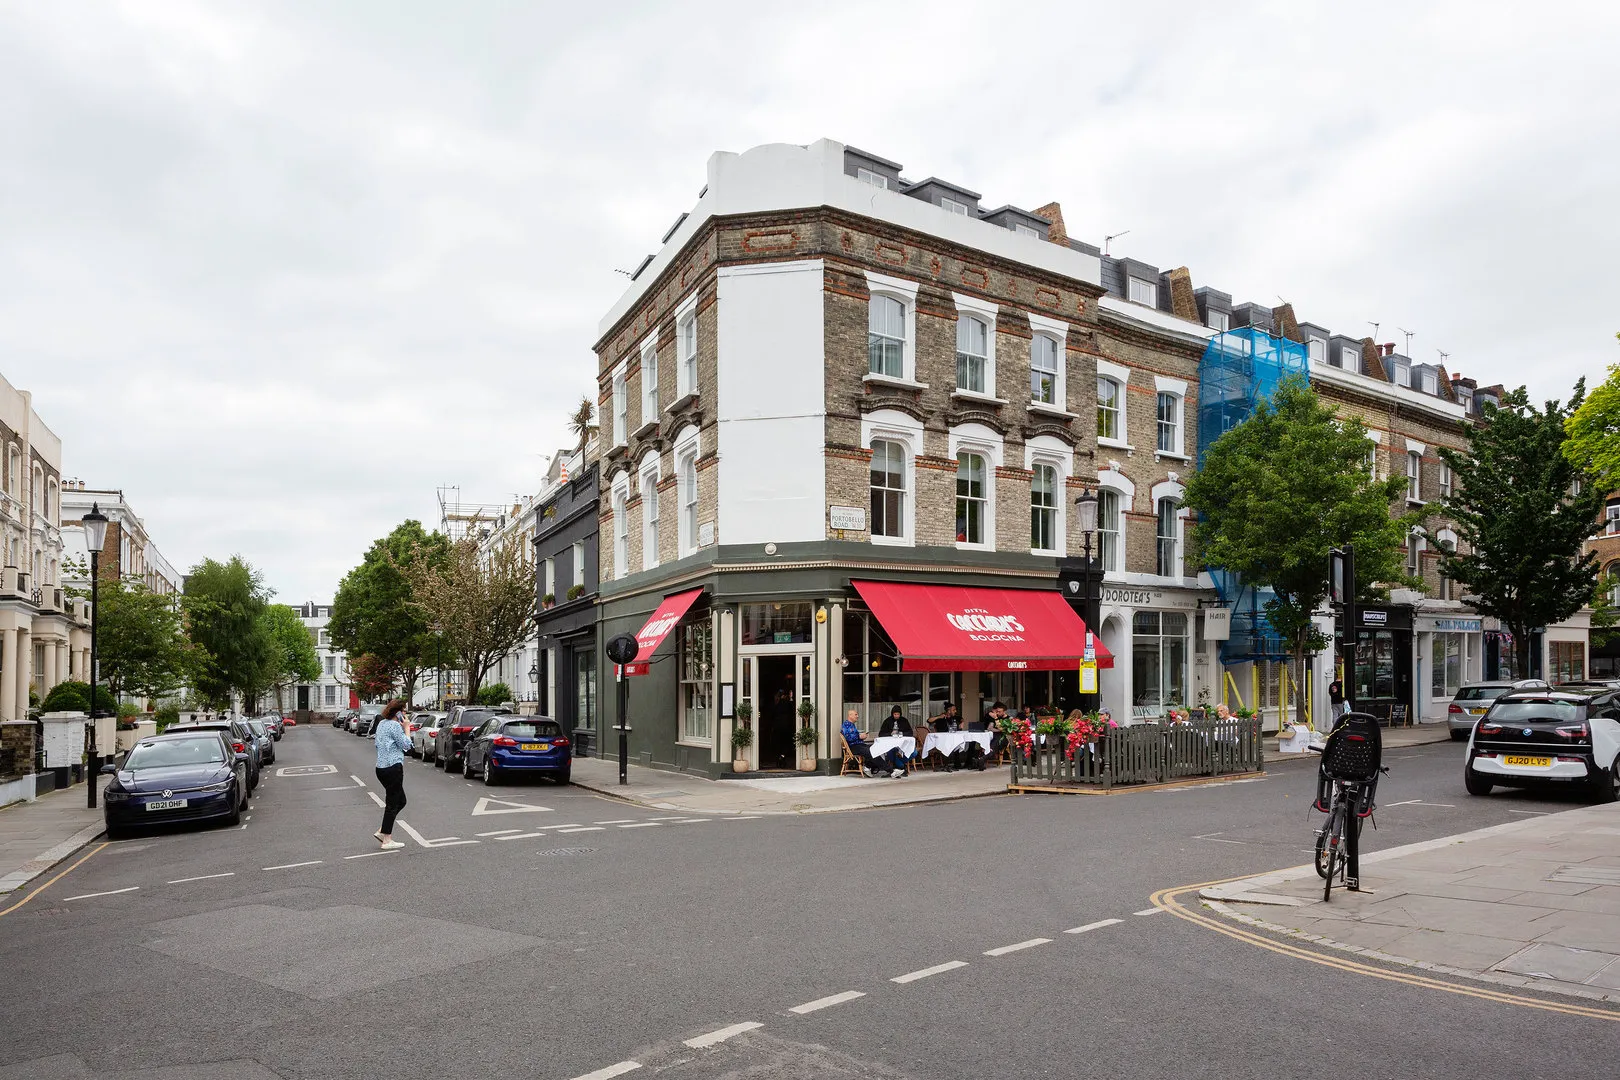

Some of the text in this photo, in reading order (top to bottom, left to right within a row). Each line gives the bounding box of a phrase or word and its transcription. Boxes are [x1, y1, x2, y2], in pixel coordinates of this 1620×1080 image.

[832, 516, 864, 524] PORTOBELLO
[1105, 590, 1151, 604] DOROTEA'S
[1453, 620, 1481, 631] PALACE
[969, 634, 1025, 642] BOLOGNA
[1507, 757, 1548, 766] GJ20 LVS
[151, 801, 168, 809] GD21
